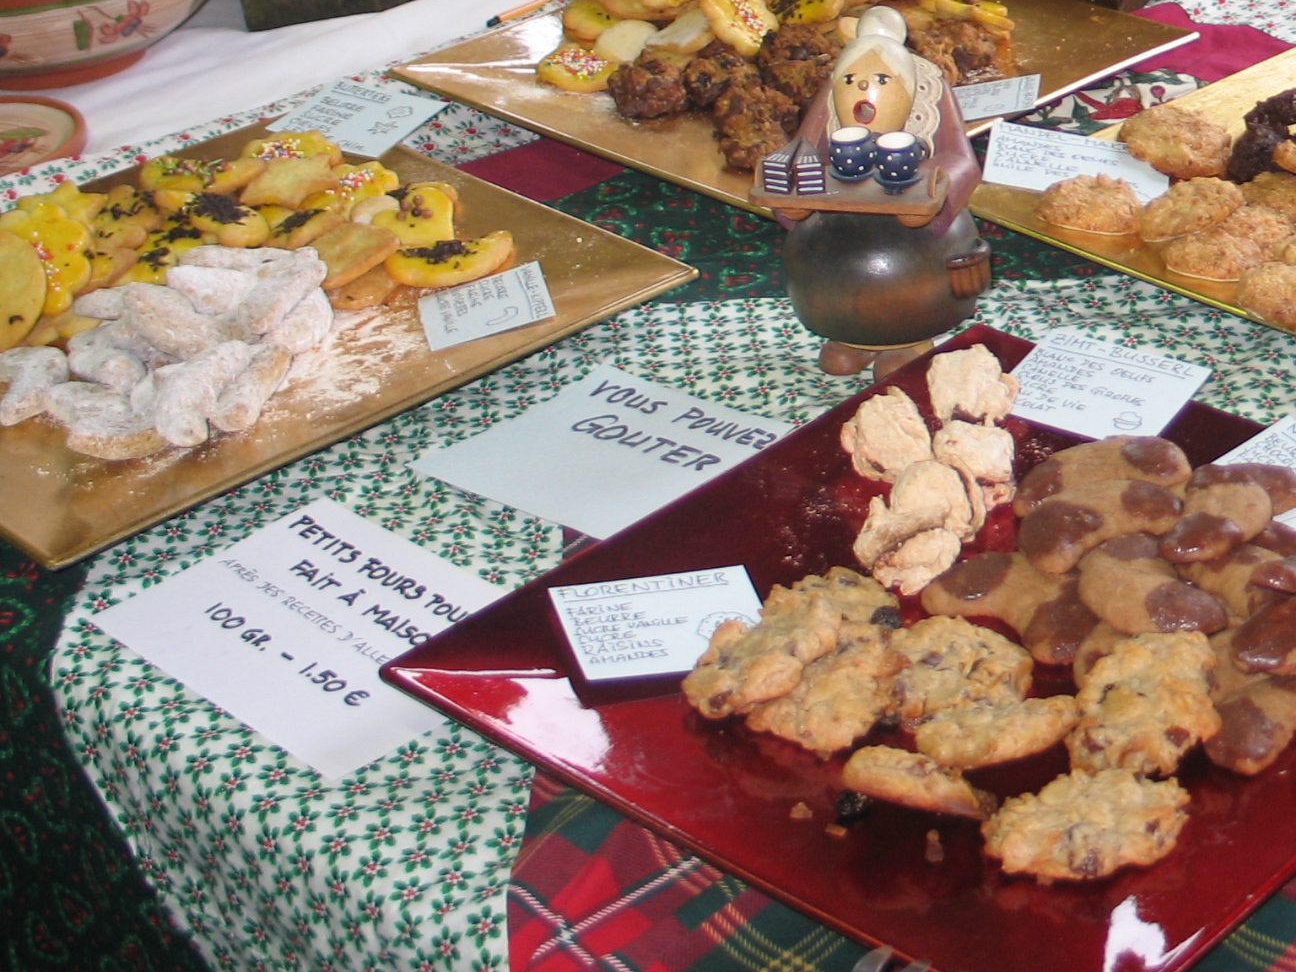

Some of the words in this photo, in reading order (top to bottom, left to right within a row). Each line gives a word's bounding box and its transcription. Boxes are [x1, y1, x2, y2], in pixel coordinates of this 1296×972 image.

[1030, 354, 1096, 378] AMANDES
[1082, 359, 1105, 371] DES
[1110, 367, 1157, 384] OEUFS
[1061, 381, 1087, 392] DES
[1035, 393, 1060, 403] DE
[1062, 398, 1087, 411] VIE
[589, 379, 668, 414] VOUS
[671, 407, 778, 450] POUVEZ
[571, 414, 721, 471] GOUTER
[288, 514, 362, 564] PETITS
[357, 557, 427, 601] FOURS
[424, 593, 472, 624] POU
[558, 571, 729, 599] FLORENTINER
[289, 559, 342, 591] FAIT
[361, 603, 432, 647] MAISO
[566, 601, 632, 617] FARINE
[256, 581, 285, 598] DES
[282, 595, 342, 635] RECETTES
[337, 630, 393, 666] D'ALLE
[570, 611, 646, 627] BEURRE
[574, 623, 621, 637] SUCRE
[627, 616, 689, 630] VANILLE
[578, 630, 638, 645] SUCRE
[580, 638, 665, 656] RAISINS
[204, 602, 246, 629] 100
[240, 627, 273, 651] GR.
[299, 662, 347, 693] 1.50
[343, 689, 370, 707] €
[589, 648, 670, 665] AMANDES
